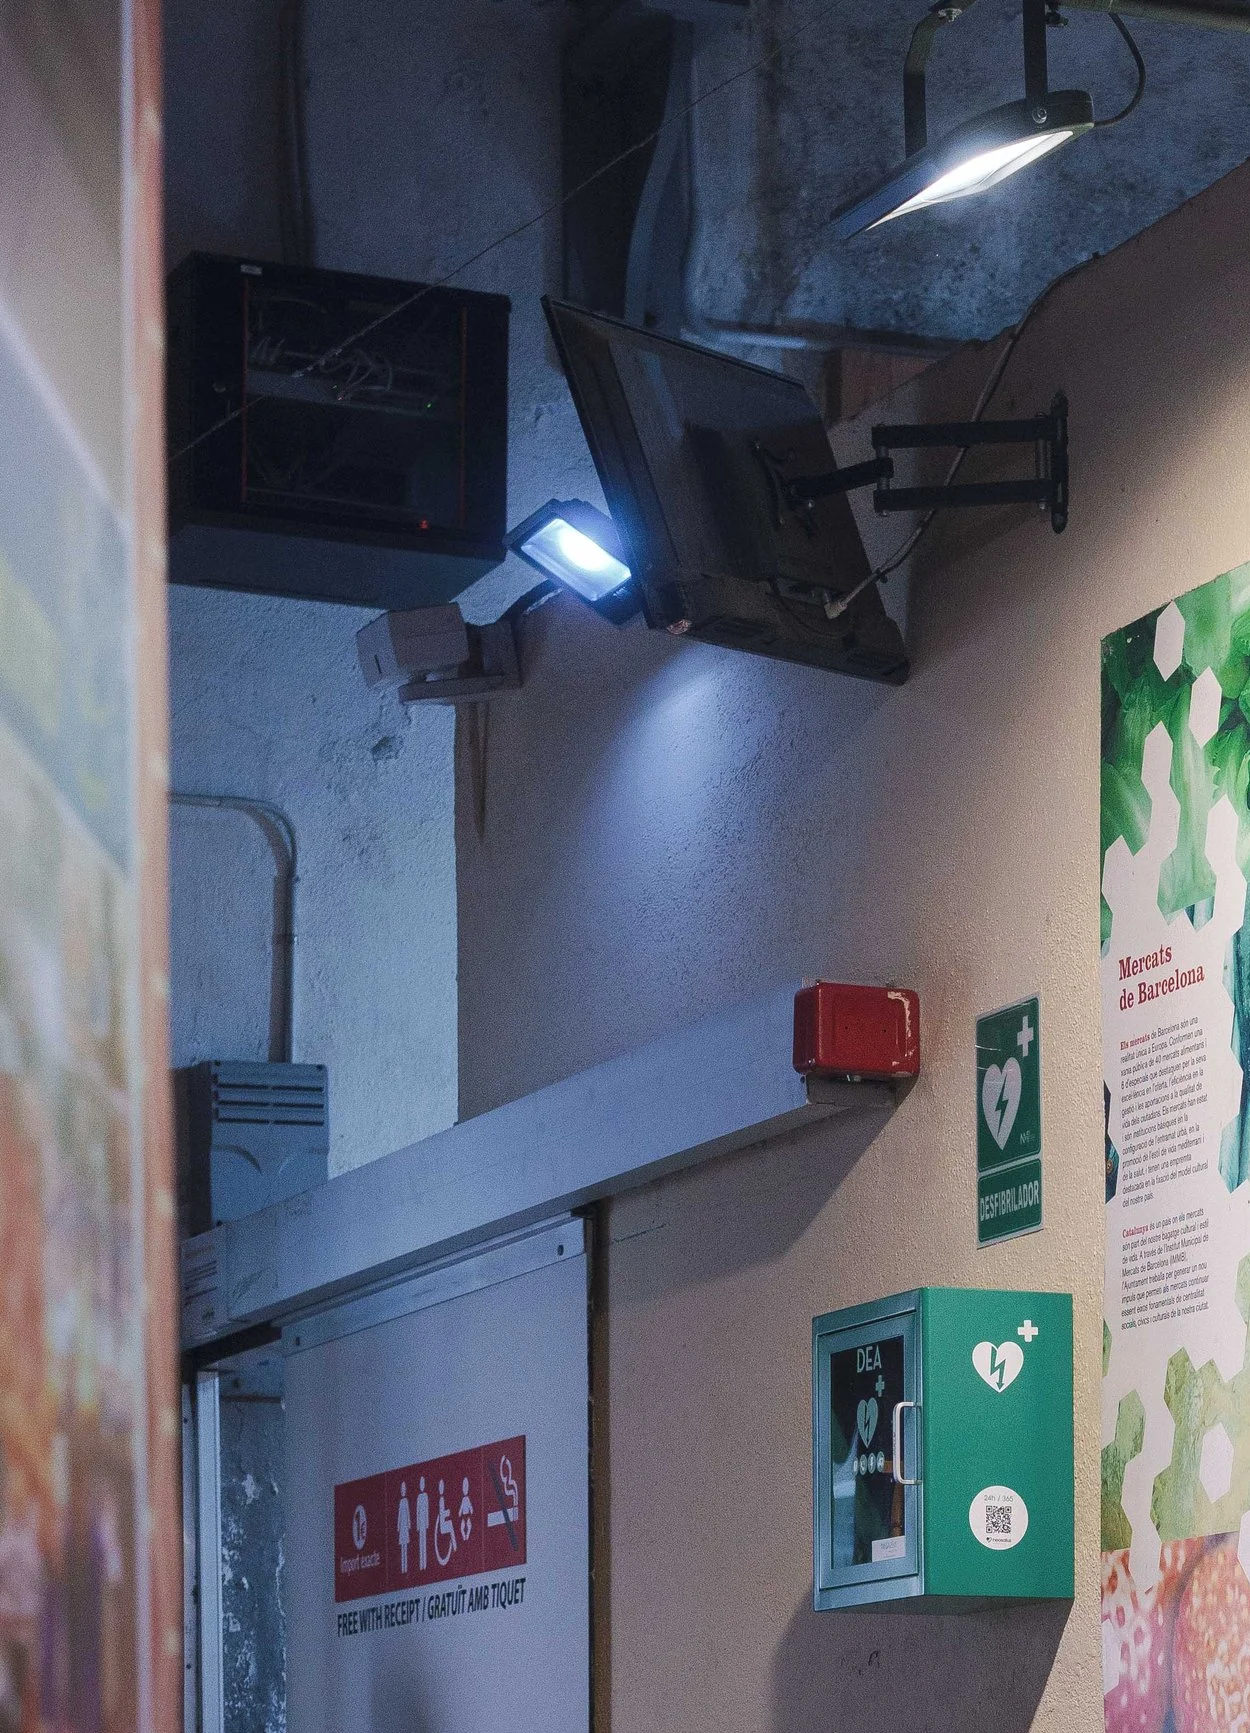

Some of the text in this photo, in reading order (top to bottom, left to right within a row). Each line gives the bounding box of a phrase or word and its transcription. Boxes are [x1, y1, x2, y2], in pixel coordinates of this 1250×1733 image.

[1119, 944, 1172, 981] Mercats
[1120, 966, 1204, 1011] de Barcelona
[980, 1180, 1039, 1222] DESFIBRILADOR
[857, 1345, 882, 1373] DEA
[337, 1611, 358, 1637] FREE
[359, 1605, 383, 1633] WITH
[384, 1598, 420, 1628] RECEIPT
[422, 1596, 427, 1622] /
[467, 1585, 490, 1613] AMB
[491, 1577, 526, 1609] TIQUET
